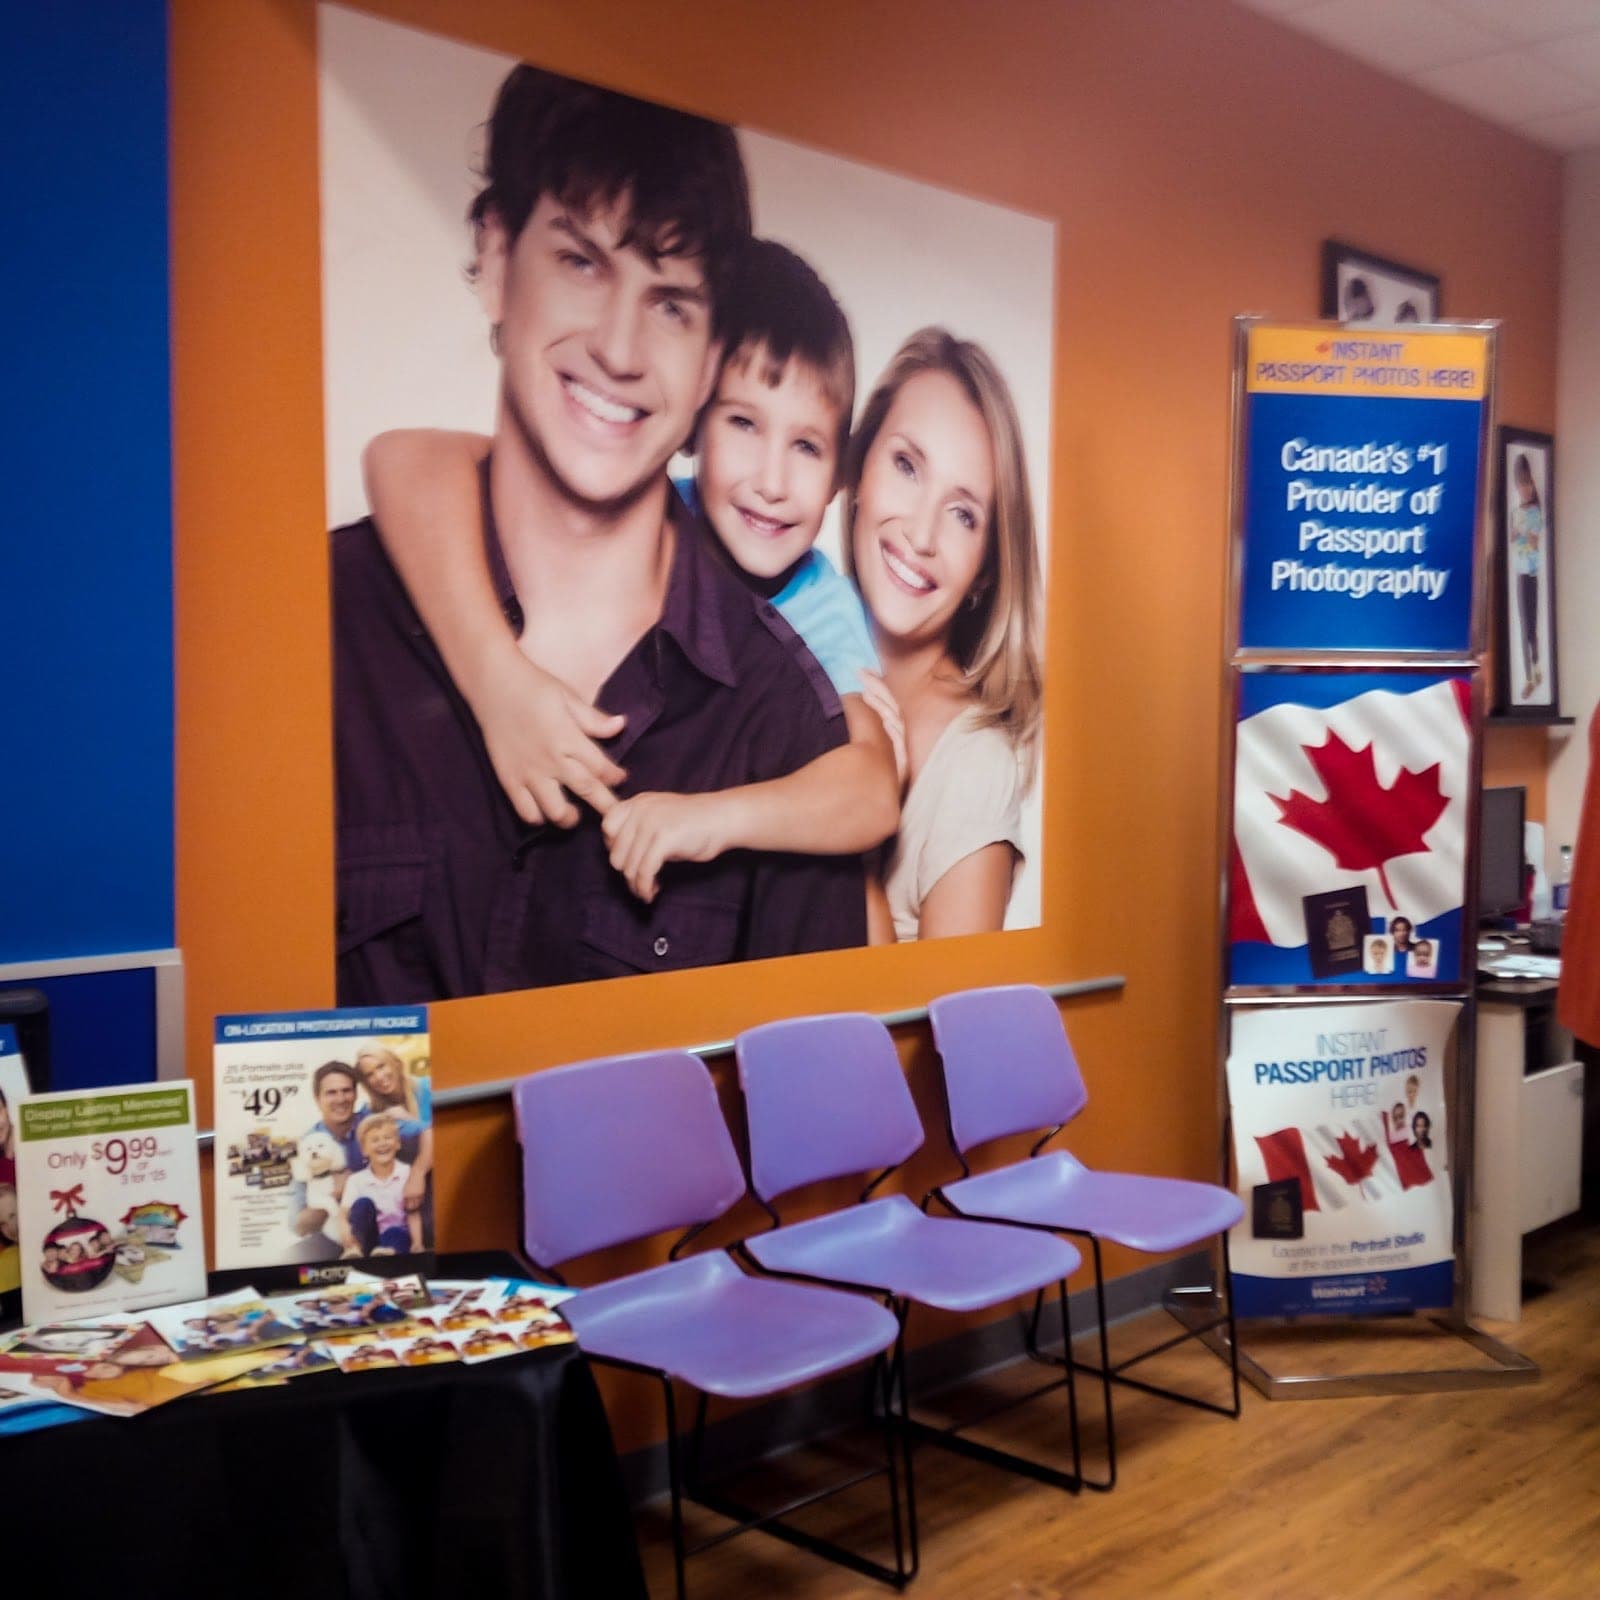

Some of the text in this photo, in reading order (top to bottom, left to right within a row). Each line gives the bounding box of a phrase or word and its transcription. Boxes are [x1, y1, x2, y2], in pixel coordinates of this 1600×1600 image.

[1332, 341, 1403, 361] INSTANT
[1256, 363, 1475, 389] PASSPORT PHOTOS HERE!
[1281, 438, 1447, 475] Canada's #1
[1287, 481, 1444, 514] Provider of
[1299, 521, 1425, 559] Passport
[1271, 561, 1448, 600] Photography
[223, 1016, 419, 1037] ON-LOCATION PHOTOGRAPHY PACKAGE
[1316, 1029, 1388, 1057] INSTANT
[1254, 1046, 1427, 1085] PASSPORT PHOTOS
[48, 1151, 87, 1170] Only
[1351, 1237, 1392, 1253] Portrait
[1394, 1231, 1425, 1249] Studio
[1311, 1286, 1366, 1299] Walmart
